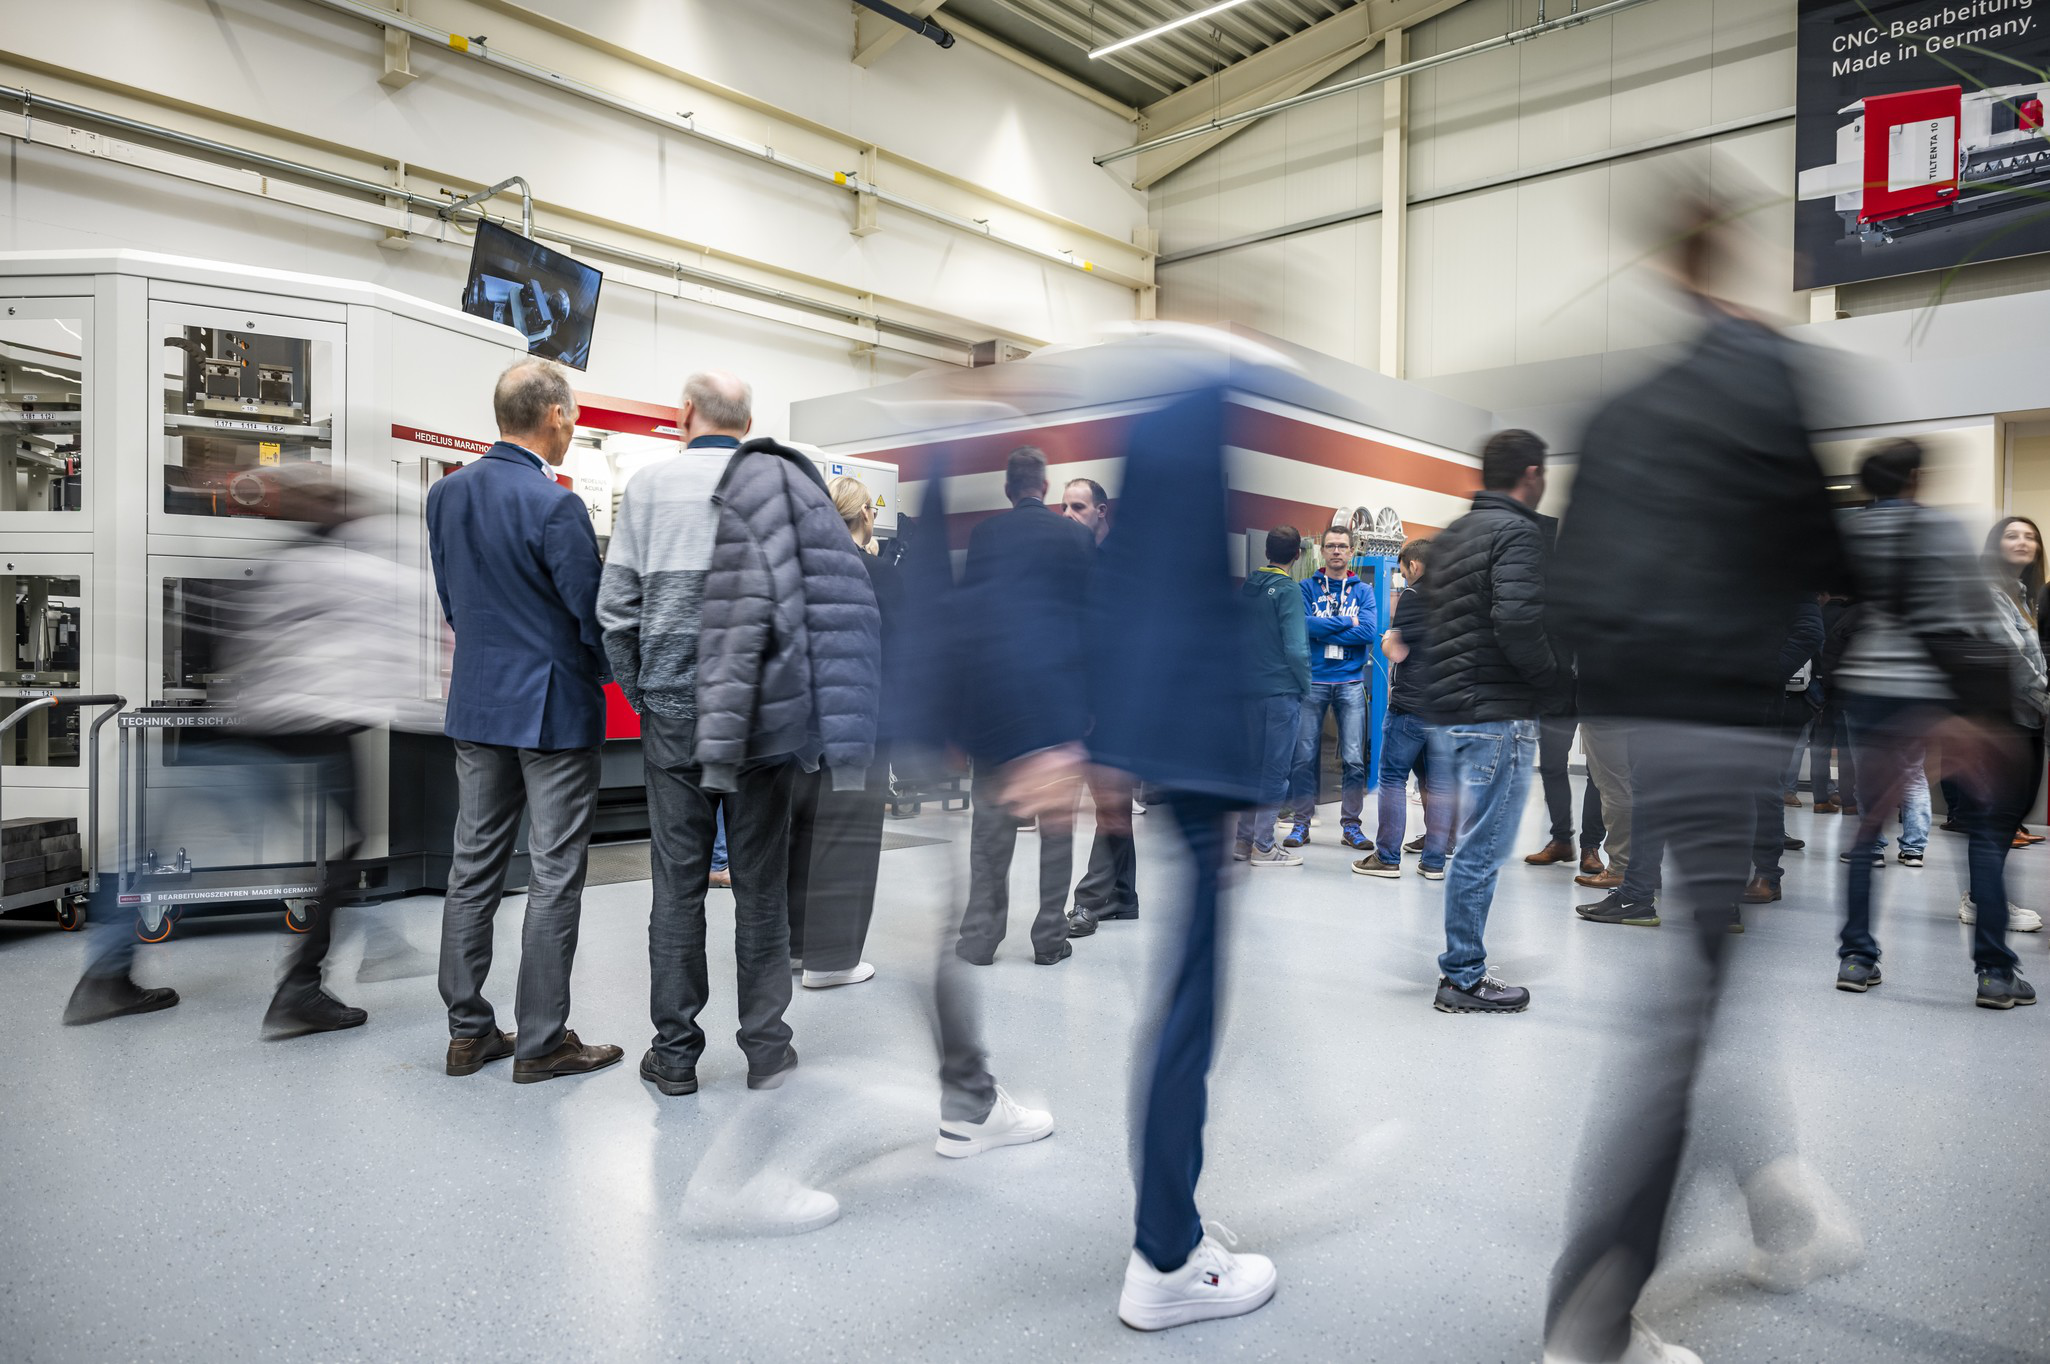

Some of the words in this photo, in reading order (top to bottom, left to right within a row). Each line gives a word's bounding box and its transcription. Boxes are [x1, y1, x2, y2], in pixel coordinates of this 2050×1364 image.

[1832, 50, 1891, 77] Made
[1898, 43, 1917, 61] in
[1925, 15, 2037, 54] Germany.
[1930, 122, 1939, 133] 10
[1929, 134, 1938, 180] TILTENTA
[415, 431, 453, 446] HEDELIUS
[454, 439, 492, 453] MARATHO
[120, 717, 174, 727] TECHNIK,
[176, 717, 195, 726] DIE
[197, 716, 224, 726] SICH
[158, 890, 249, 901] BEARBEITUNGSZENTREN
[283, 886, 319, 895] GERMANY
